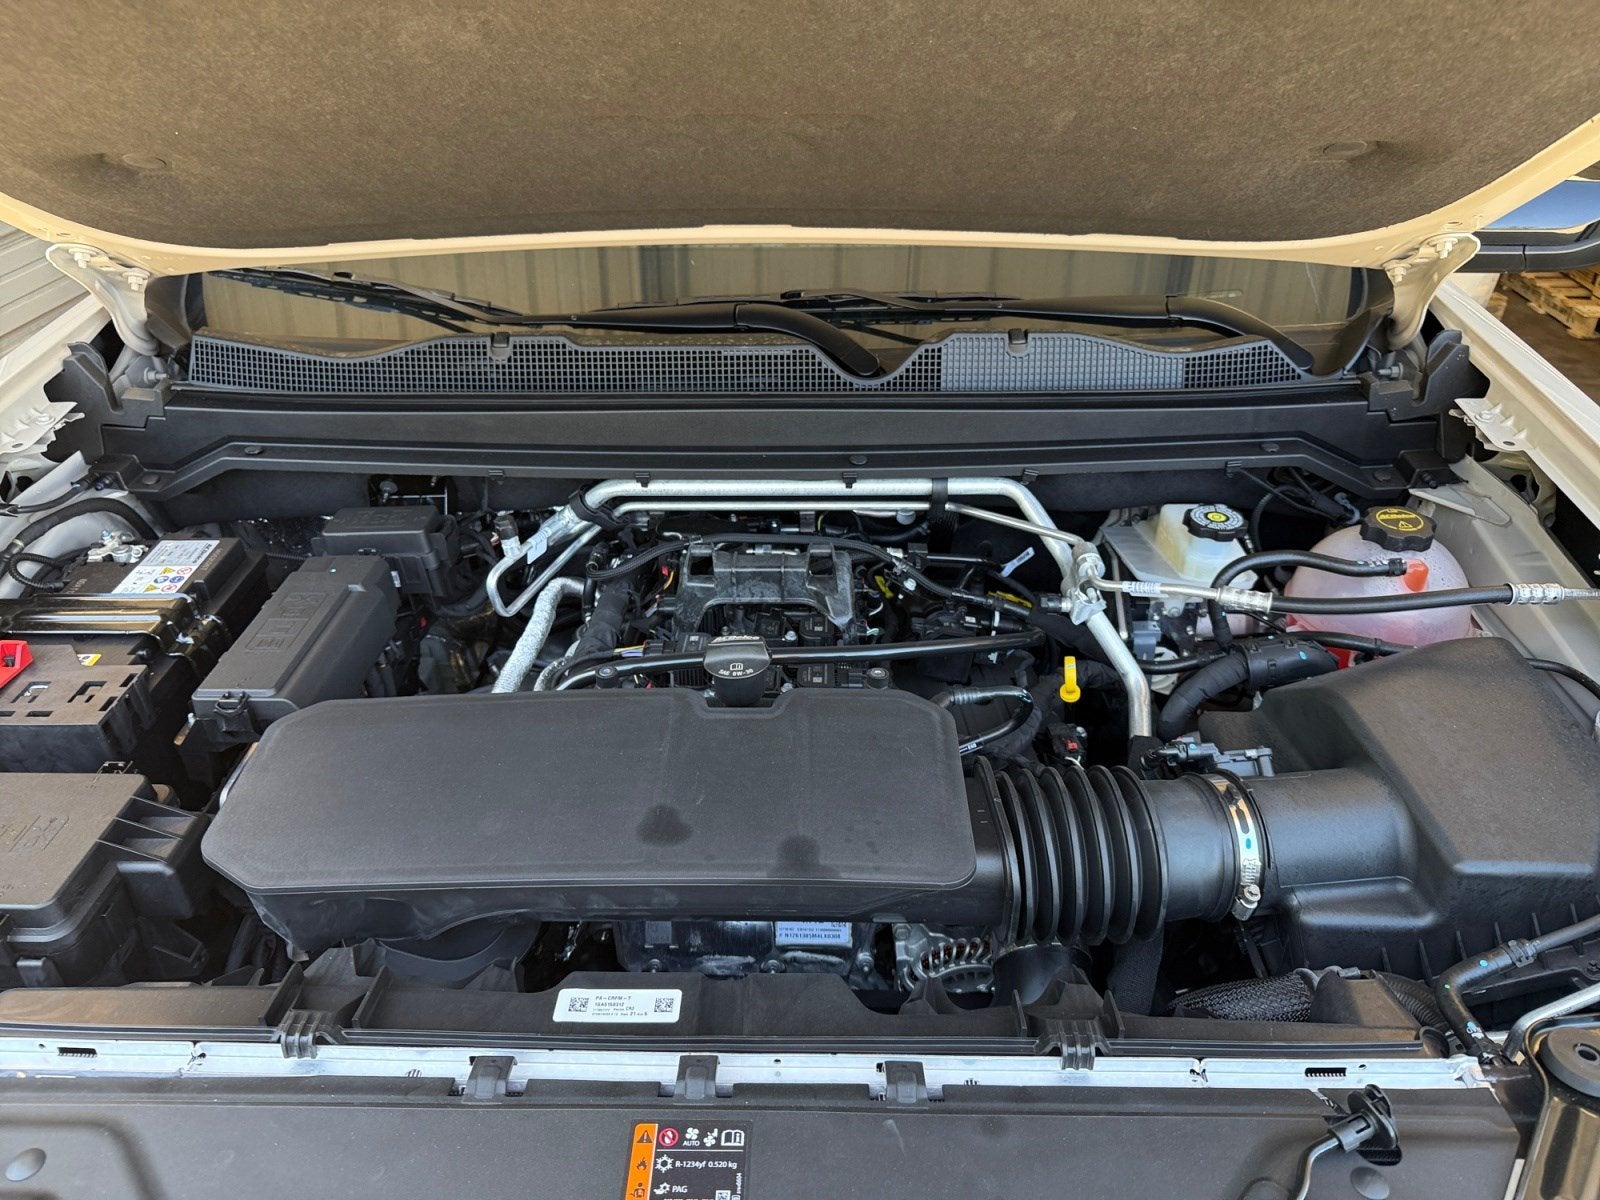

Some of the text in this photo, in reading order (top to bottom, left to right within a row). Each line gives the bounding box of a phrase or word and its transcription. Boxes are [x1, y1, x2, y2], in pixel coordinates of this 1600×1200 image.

[675, 1160, 738, 1170] R-1234yf 0.520 kg
[672, 1185, 688, 1193] PAG
